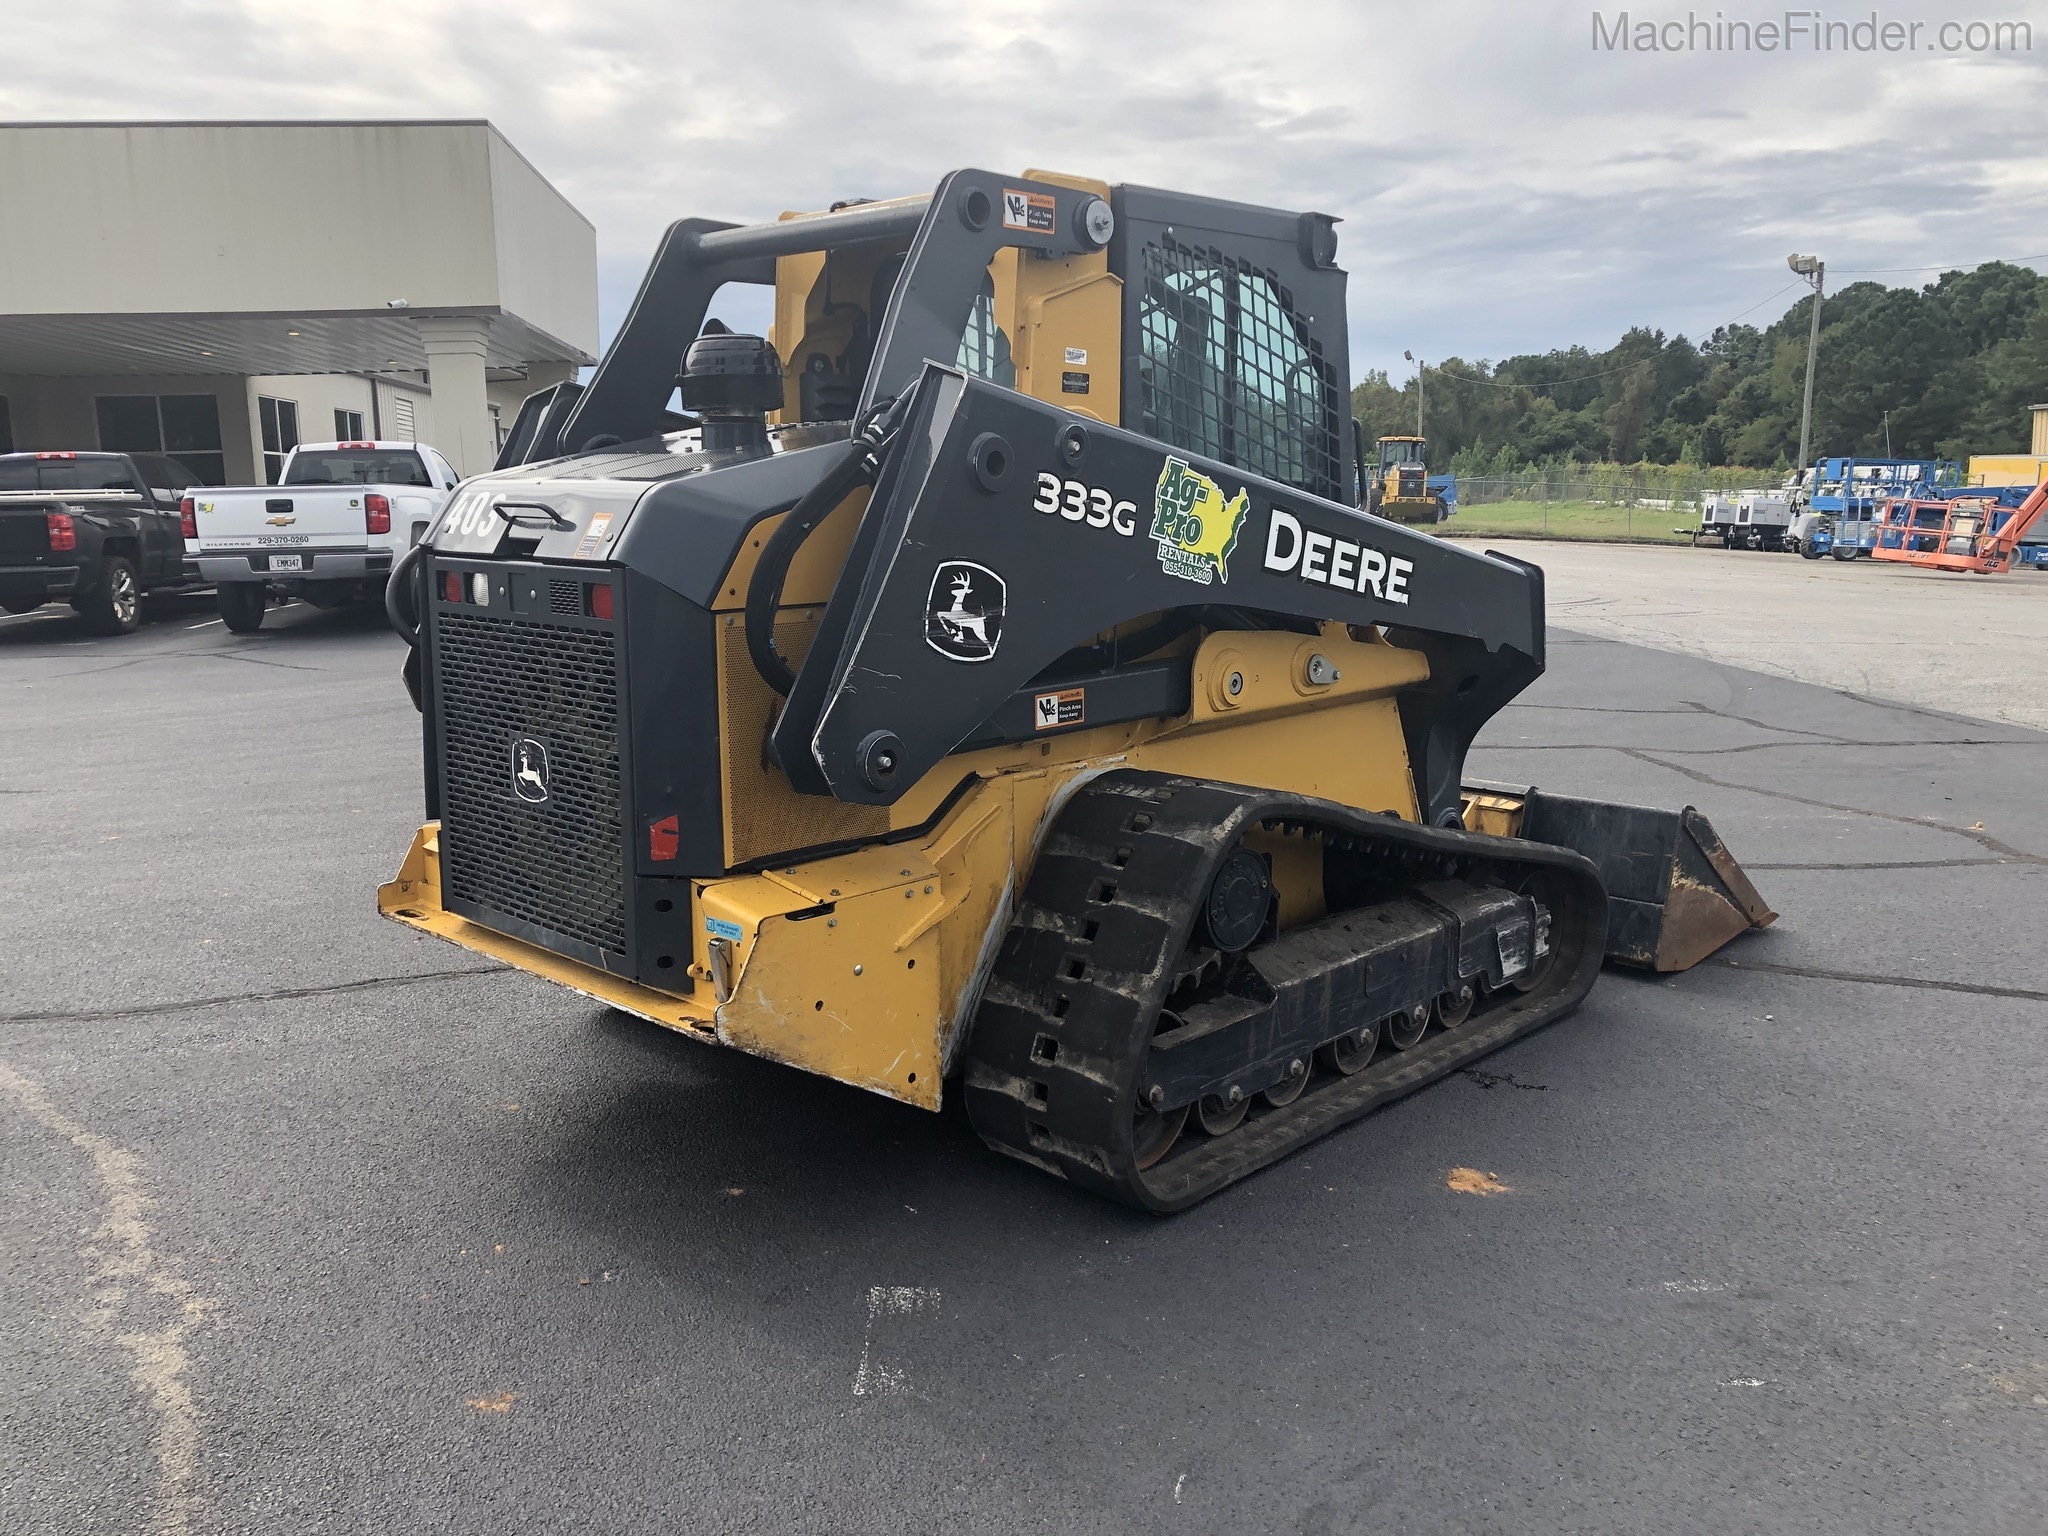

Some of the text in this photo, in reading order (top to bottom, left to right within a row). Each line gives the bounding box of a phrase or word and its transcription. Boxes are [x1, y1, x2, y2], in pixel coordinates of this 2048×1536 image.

[1029, 217, 1049, 227] Keep Away
[444, 491, 507, 537] 403
[1033, 472, 1137, 536] 333G
[1152, 498, 1204, 546] Pro
[257, 535, 310, 544] 229-370-0260
[1160, 544, 1206, 569] RENTALS
[1264, 509, 1414, 607] DEERE
[1983, 560, 2000, 568] JLG
[1164, 560, 1211, 581] 855-310-3600
